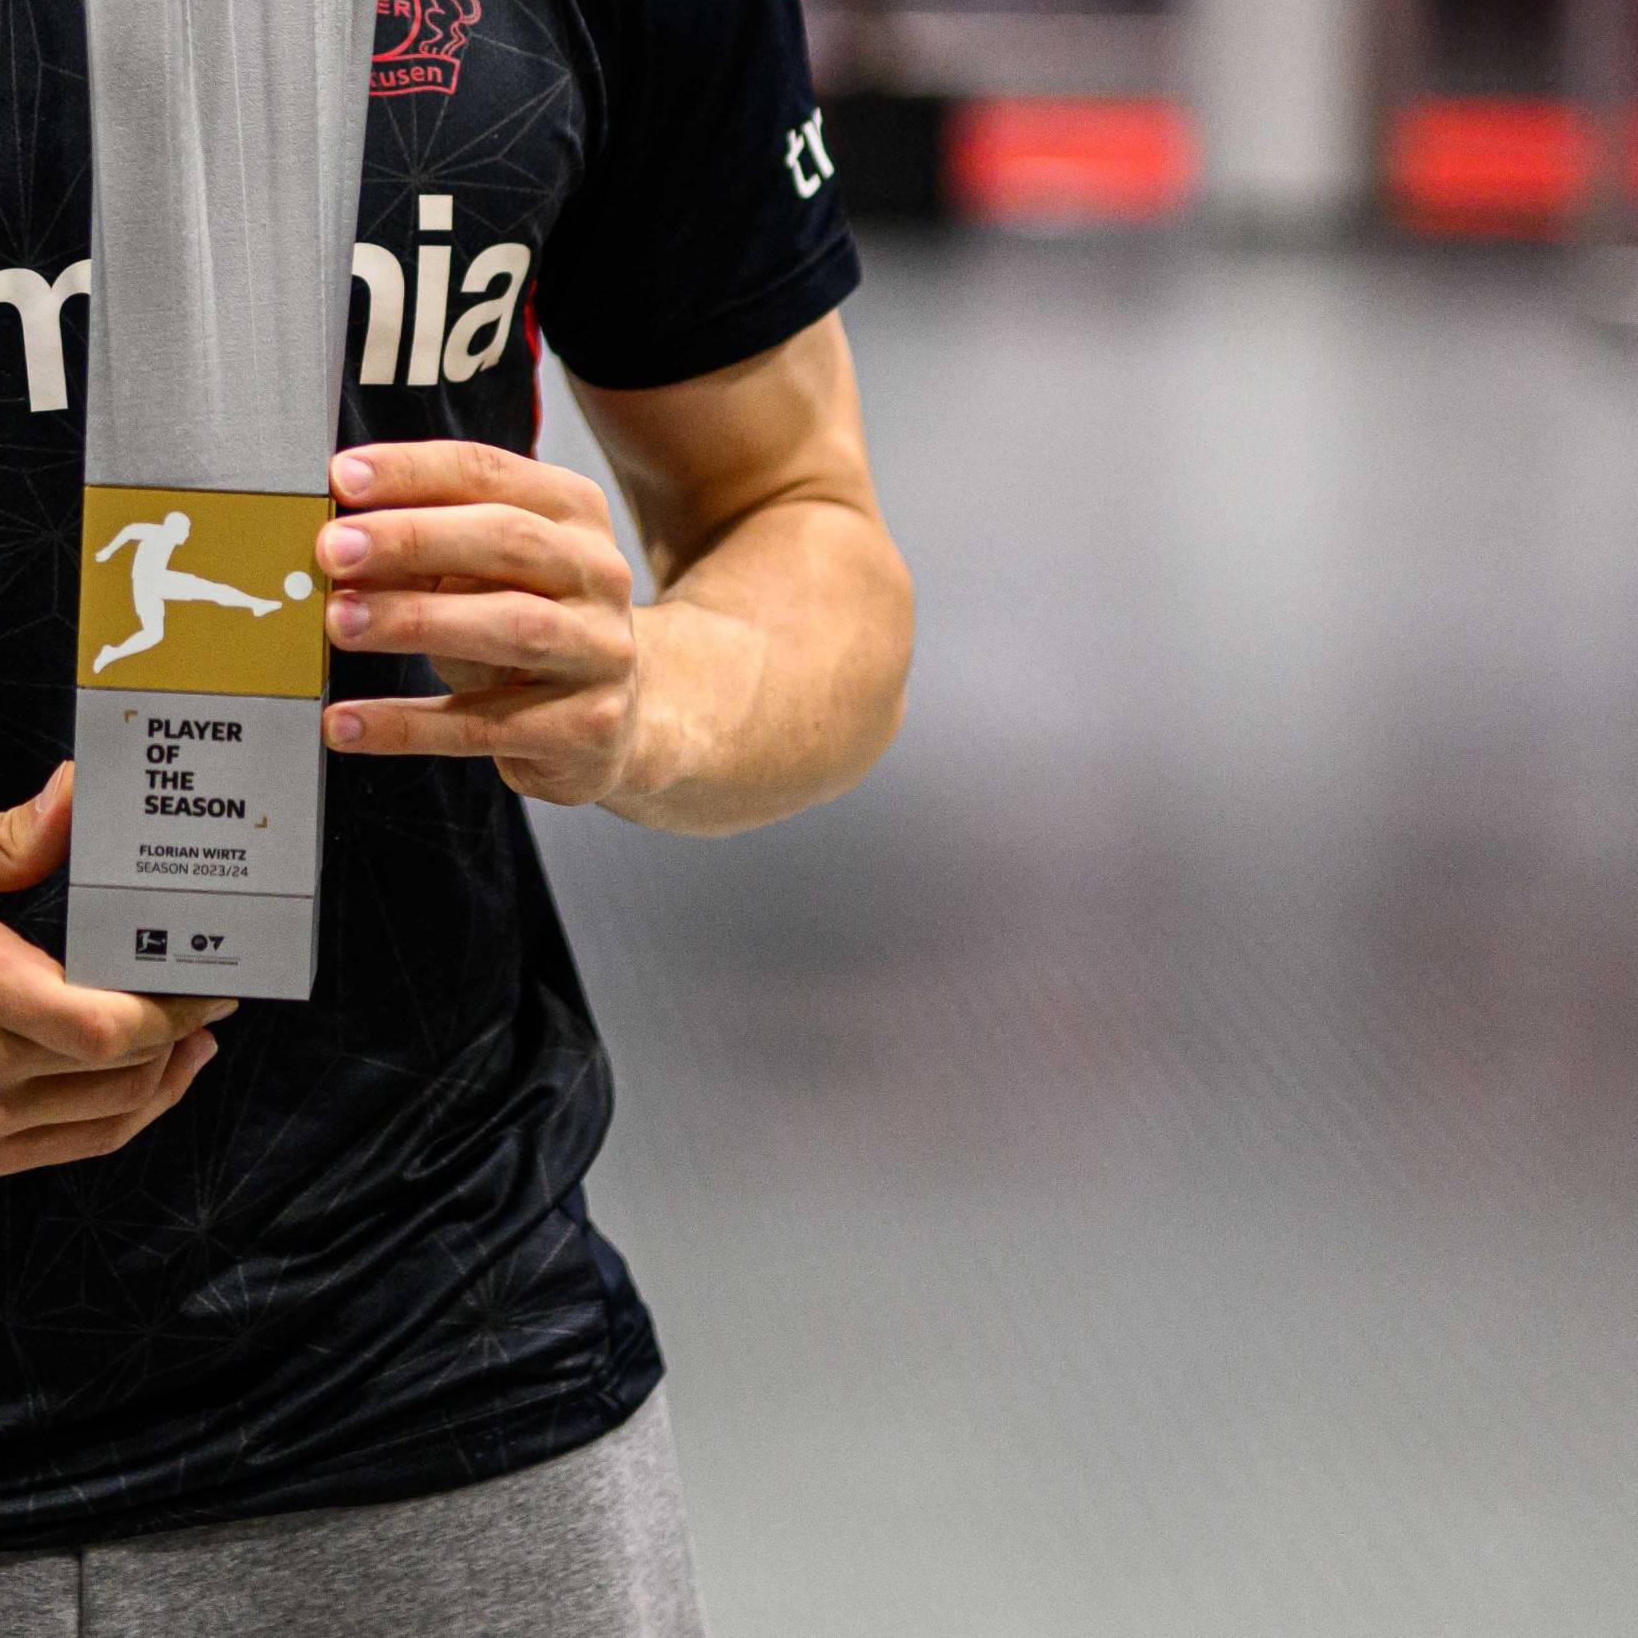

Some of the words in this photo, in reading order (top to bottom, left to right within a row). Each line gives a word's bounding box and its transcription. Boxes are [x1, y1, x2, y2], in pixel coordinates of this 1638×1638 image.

[368, 65, 443, 88] usen
[785, 106, 835, 199] tr
[147, 718, 243, 742] PLAYER
[146, 743, 180, 764] OF
[145, 769, 195, 791] THE
[144, 795, 246, 819] SEASON
[139, 844, 200, 859] FLORIAN
[202, 847, 247, 861] WIRTZ
[135, 861, 189, 875] SEASON
[192, 863, 249, 877] 2023/24
